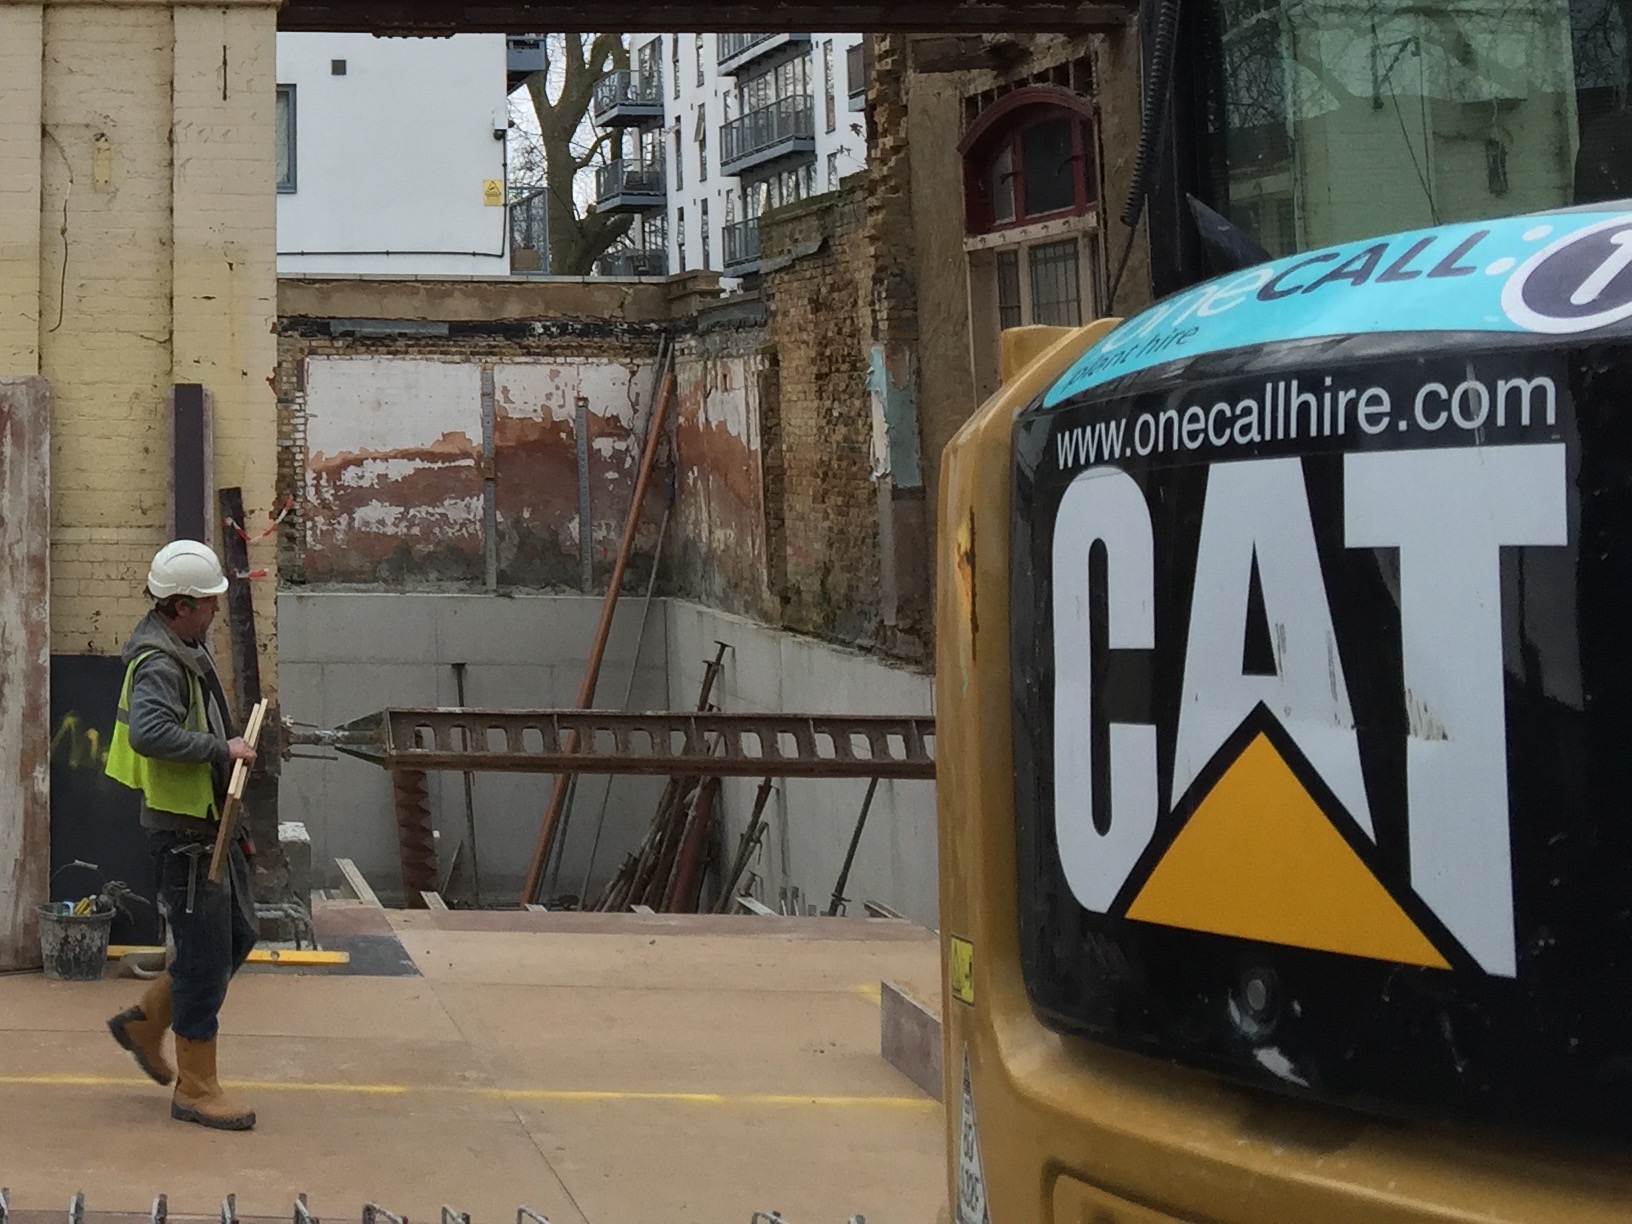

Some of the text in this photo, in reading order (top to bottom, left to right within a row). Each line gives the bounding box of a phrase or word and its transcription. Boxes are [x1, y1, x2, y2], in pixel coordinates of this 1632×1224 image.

[1136, 326, 1199, 359] hire
[1057, 376, 1557, 470] www.onecallhire.com
[1052, 443, 1568, 979] CAT
